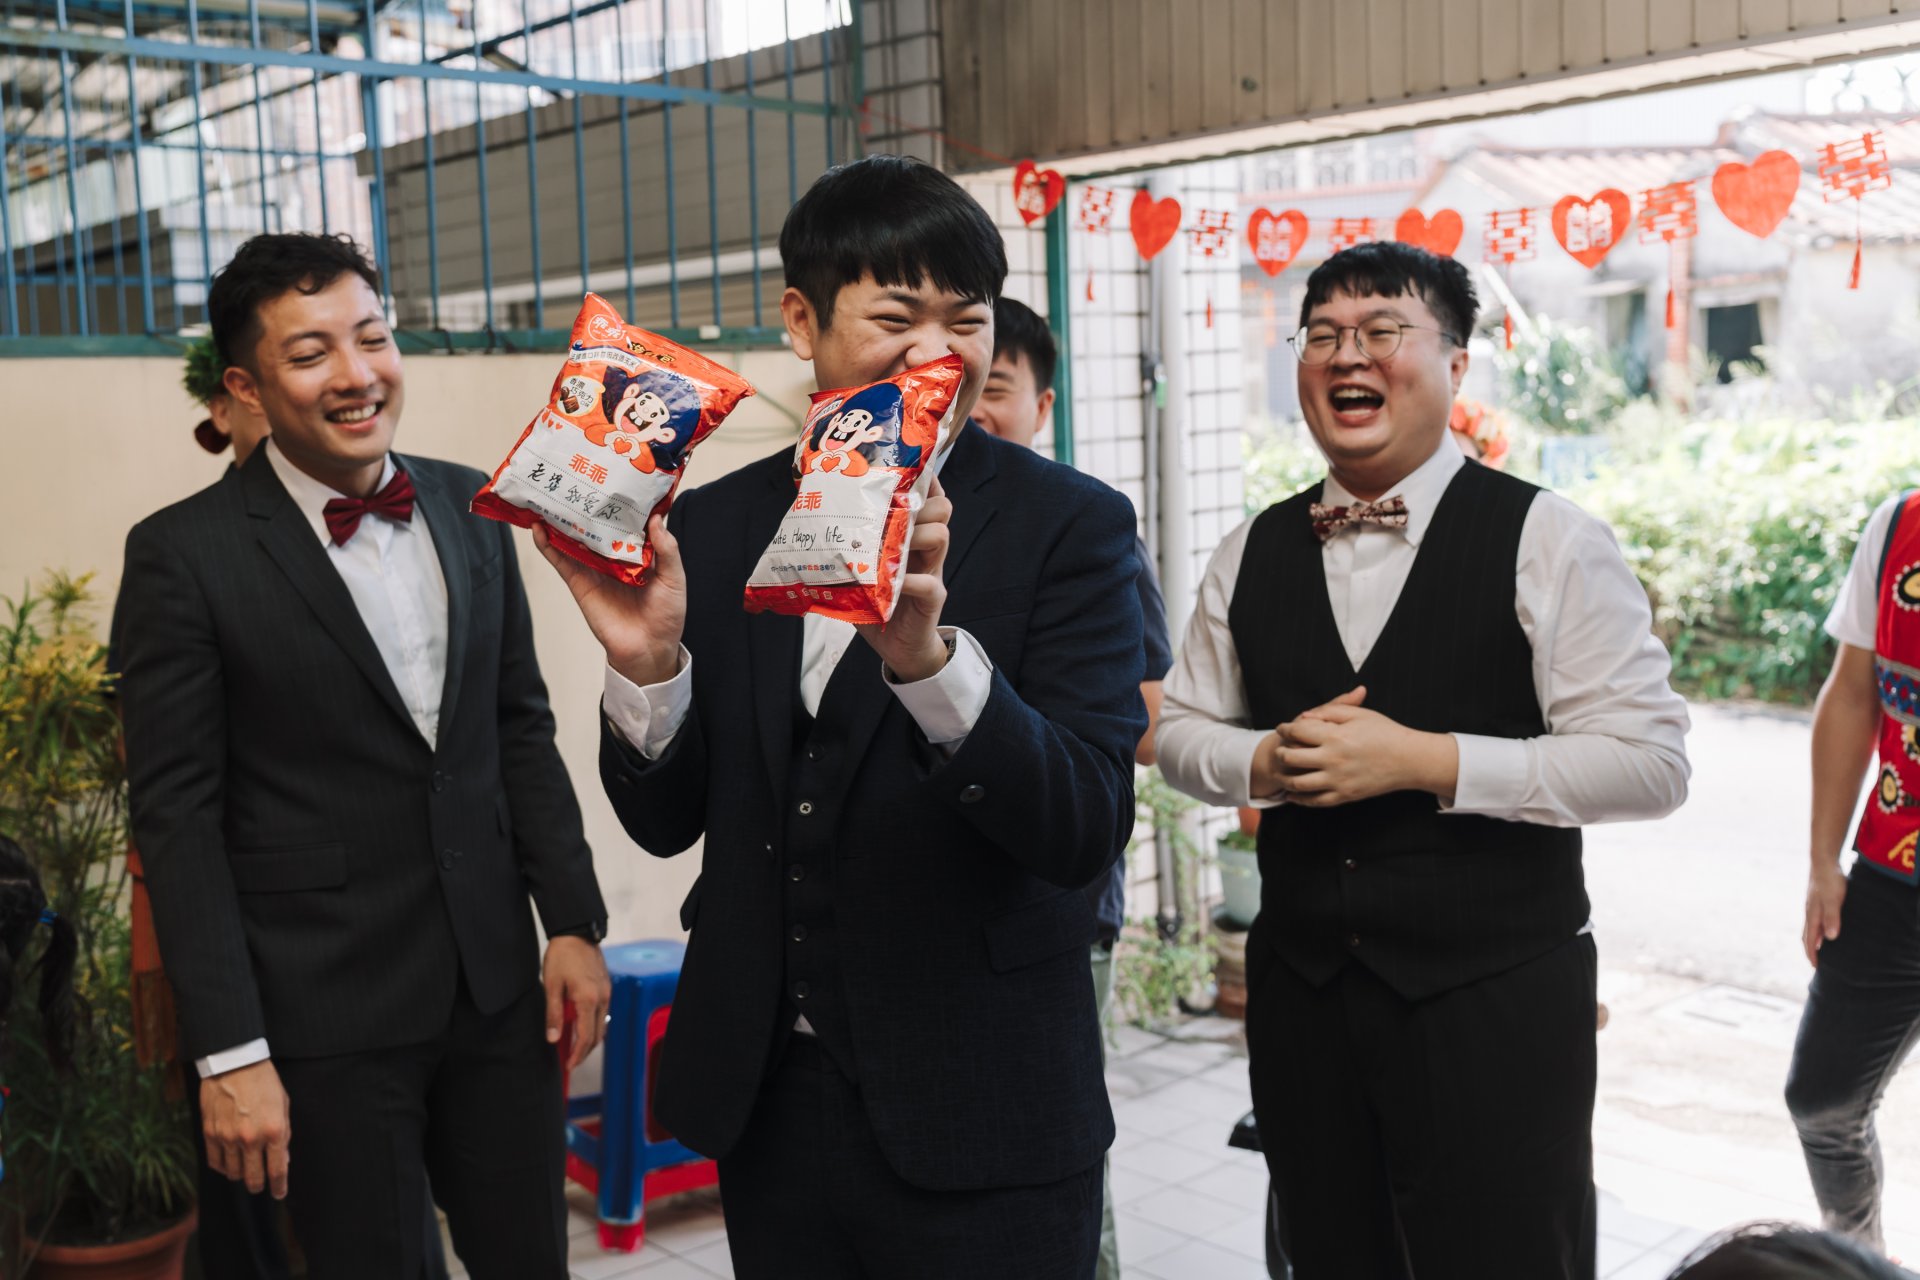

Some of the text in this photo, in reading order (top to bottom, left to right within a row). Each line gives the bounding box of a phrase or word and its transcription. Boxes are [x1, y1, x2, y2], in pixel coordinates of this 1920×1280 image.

[592, 316, 621, 338] 乖乖
[571, 386, 594, 404] 巧克力
[568, 453, 609, 485] 乖乖
[791, 527, 817, 551] Happy
[825, 525, 846, 543] life
